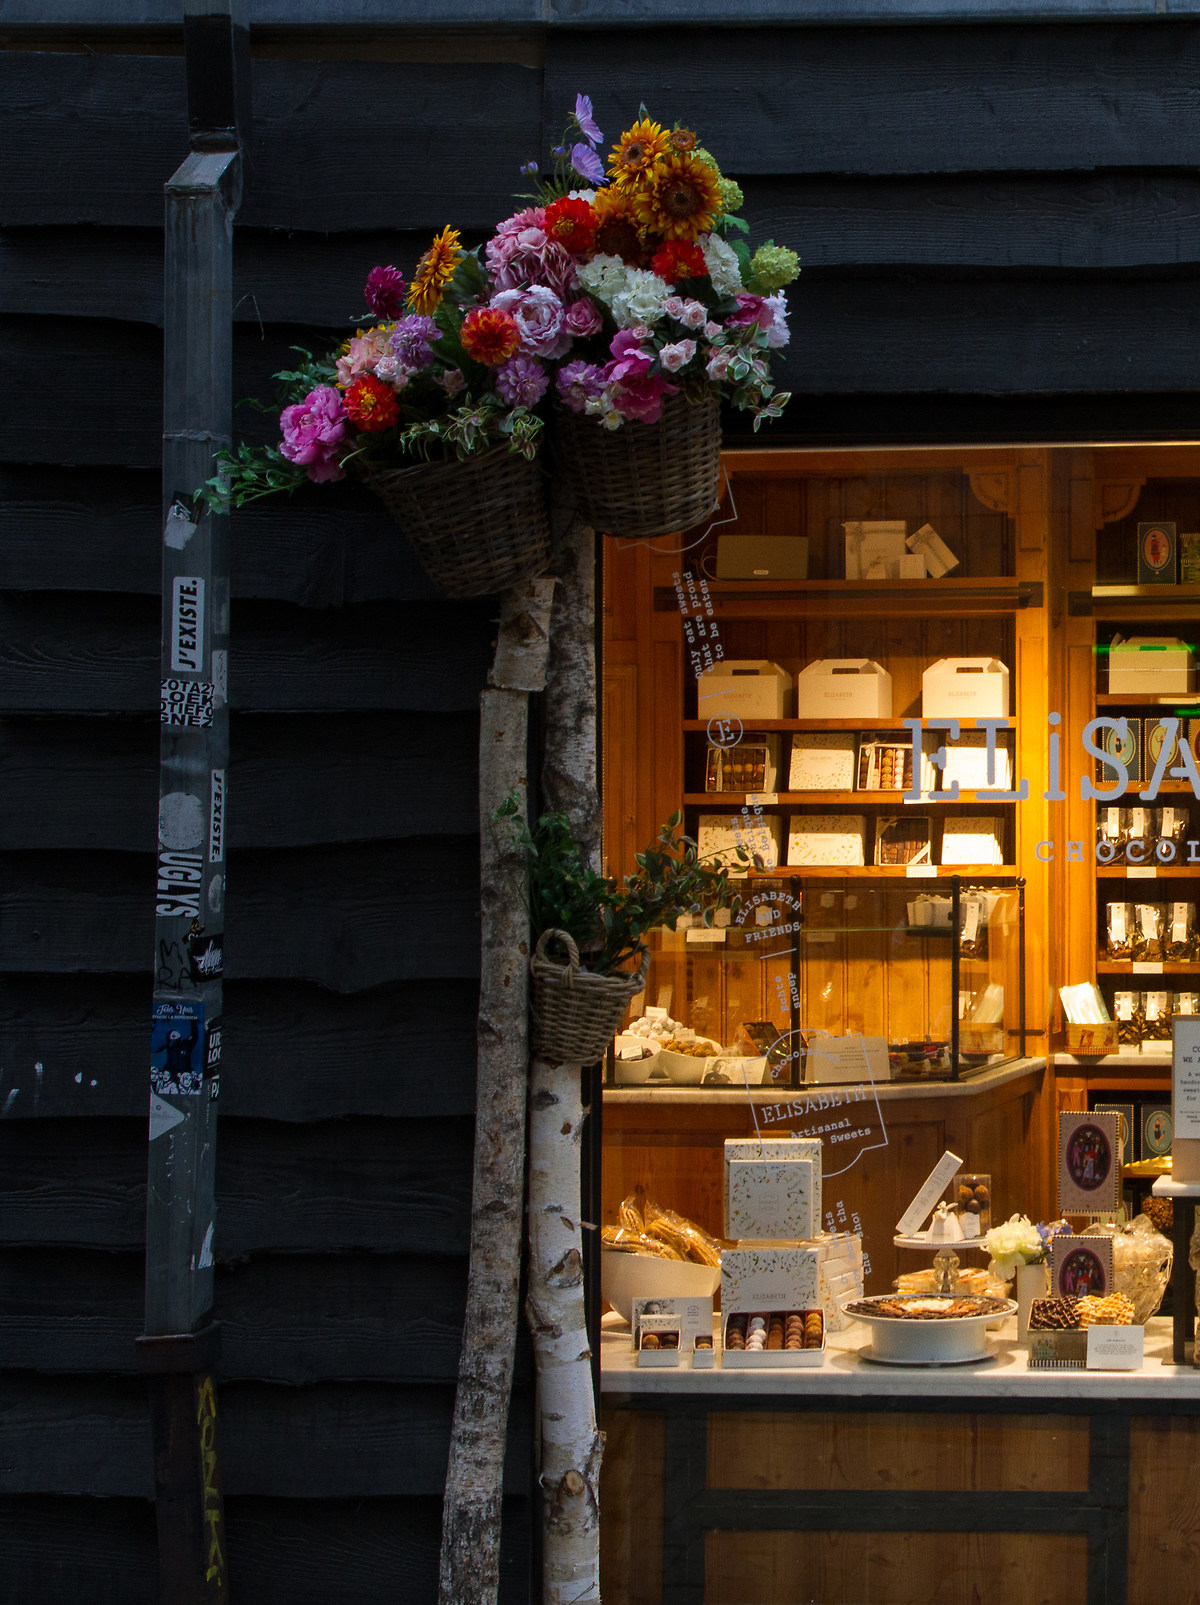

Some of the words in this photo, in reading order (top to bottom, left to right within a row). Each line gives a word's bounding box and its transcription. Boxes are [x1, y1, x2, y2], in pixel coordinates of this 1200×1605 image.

[672, 571, 688, 615] sweets
[683, 571, 701, 609] proud
[700, 579, 714, 616] eaten
[684, 622, 695, 644] eat
[696, 615, 706, 637] are
[710, 622, 719, 638] be
[702, 643, 715, 673] that
[715, 644, 724, 659] to
[735, 891, 801, 925] ELISABETH
[757, 910, 781, 922] AND
[745, 922, 800, 943] FRIENDS
[787, 972, 800, 1009] snoep
[790, 1118, 851, 1139] Artisanal
[830, 1128, 871, 1143] Sweets
